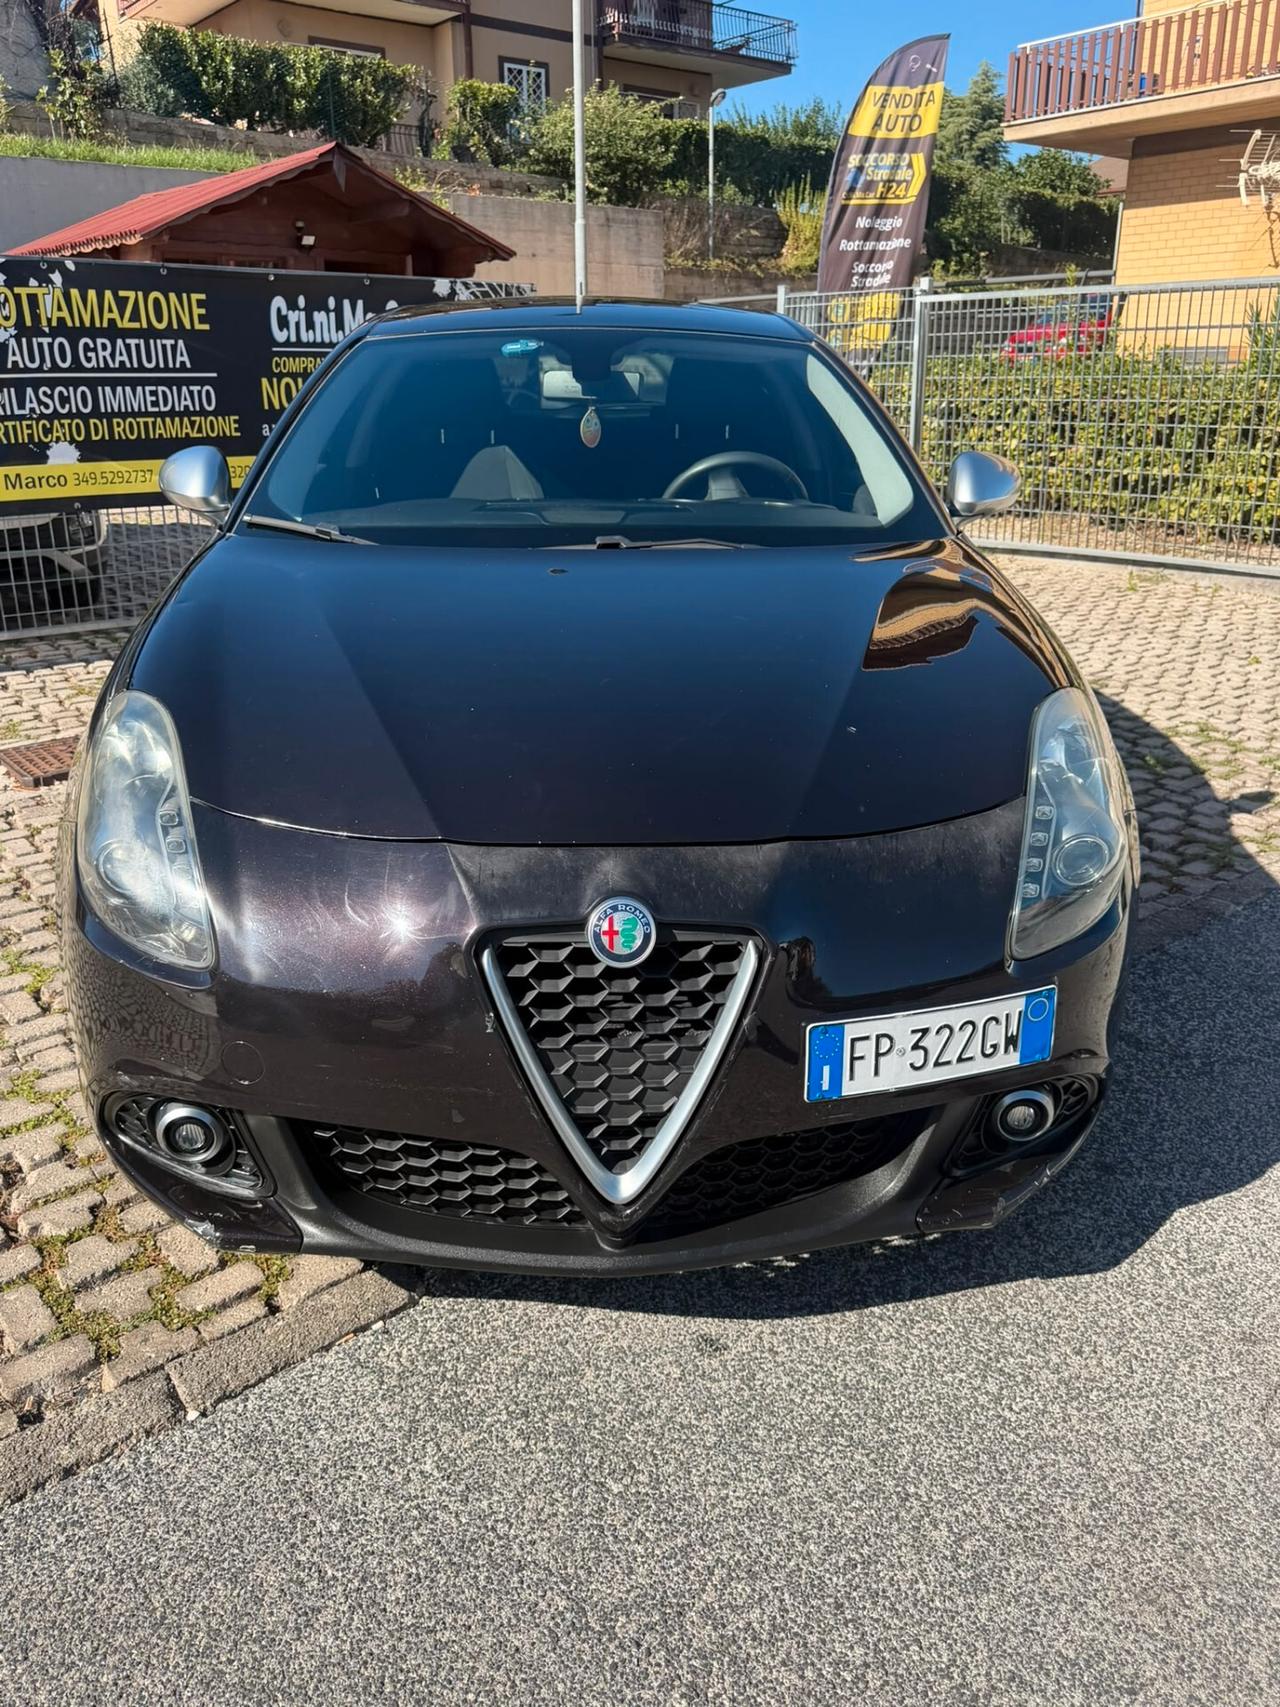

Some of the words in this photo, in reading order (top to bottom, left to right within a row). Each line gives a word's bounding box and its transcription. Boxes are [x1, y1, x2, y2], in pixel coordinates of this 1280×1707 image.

[872, 90, 936, 109] VENDITA
[871, 114, 922, 133] AUTO
[876, 182, 907, 198] H24
[855, 216, 903, 231] Noleggio
[7, 337, 72, 369] AUTO
[78, 338, 191, 369] GRATUITA
[97, 385, 216, 413] IMMEDIATO
[90, 419, 109, 441] DI
[114, 415, 241, 440] ROTTAMAZIONE
[4, 472, 68, 490] Marco
[73, 469, 153, 487] 349.5292737
[594, 908, 613, 933] ALFA
[617, 904, 651, 933] ROMEO
[849, 1033, 896, 1081] FP
[909, 1008, 1023, 1071] 322GW
